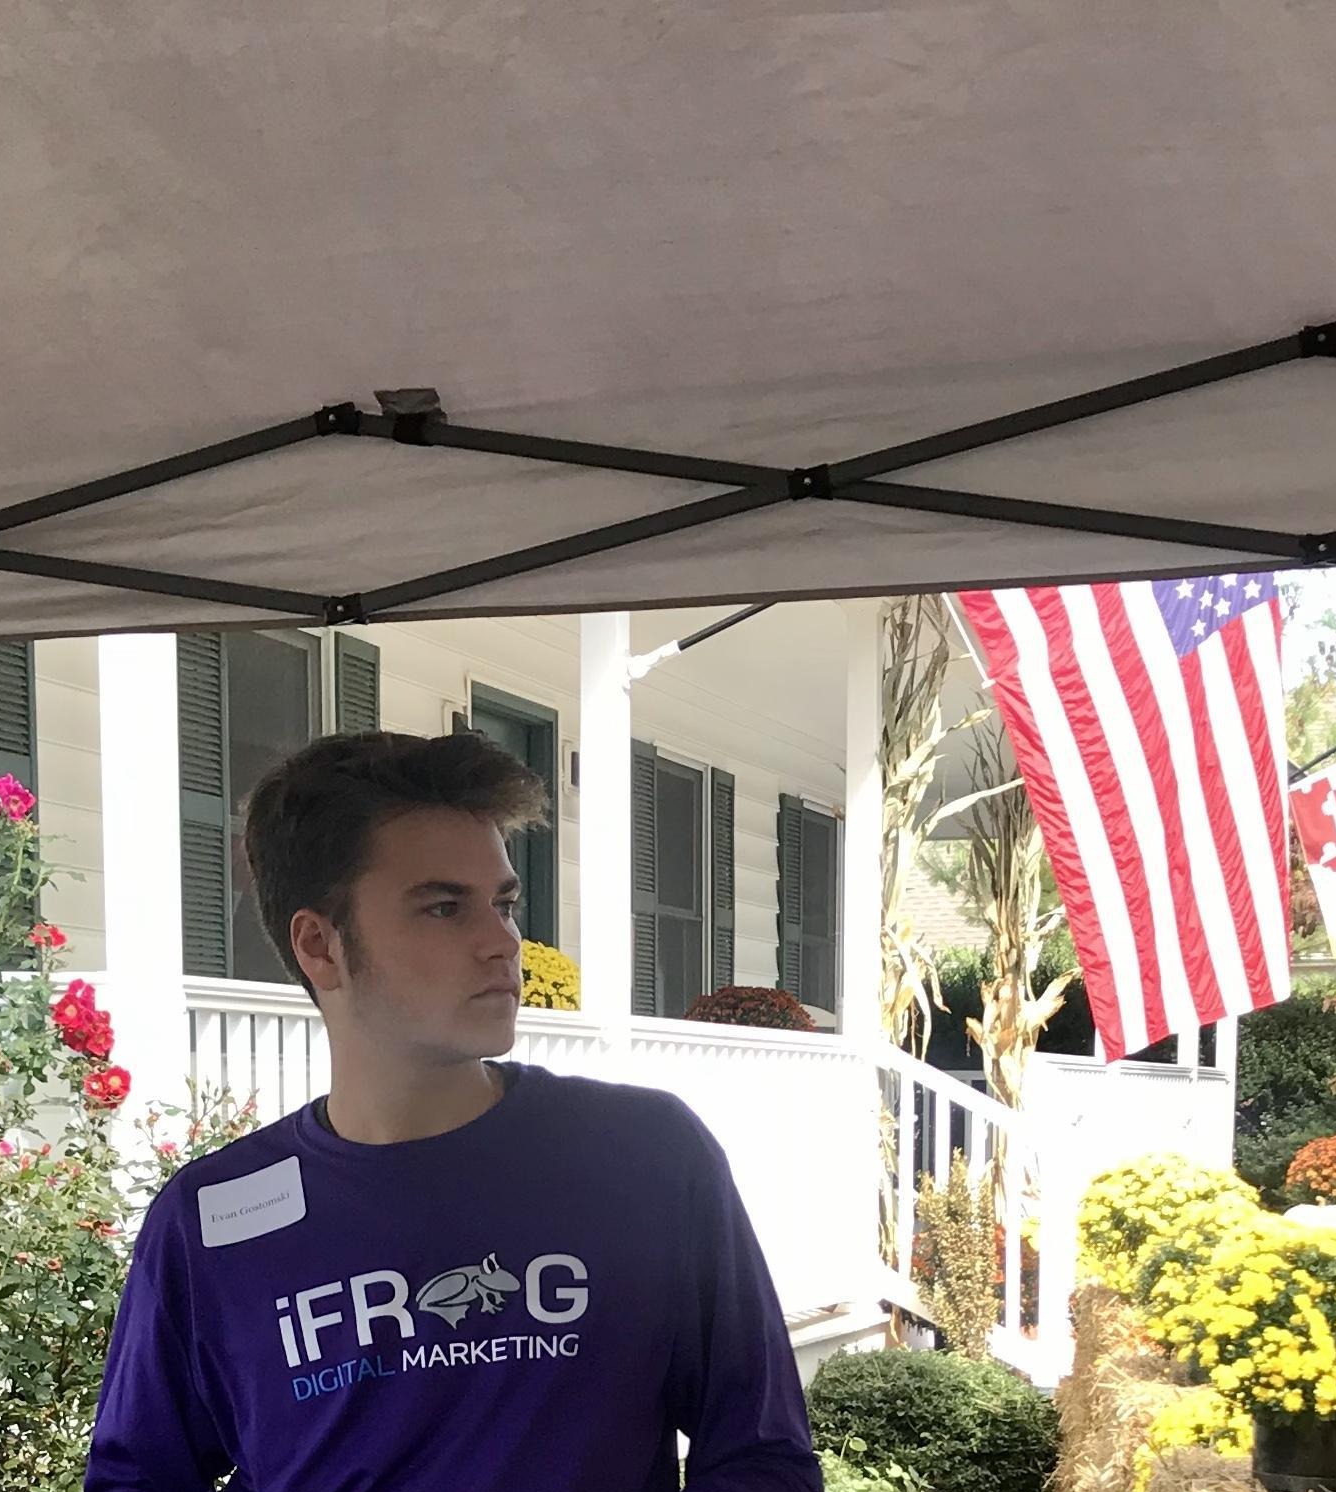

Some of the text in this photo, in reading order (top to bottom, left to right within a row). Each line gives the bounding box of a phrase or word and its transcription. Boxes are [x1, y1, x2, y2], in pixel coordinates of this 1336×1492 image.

[211, 1191, 290, 1223] Evan Gostomski
[292, 1333, 581, 1402] DIGITAL MARKETING
